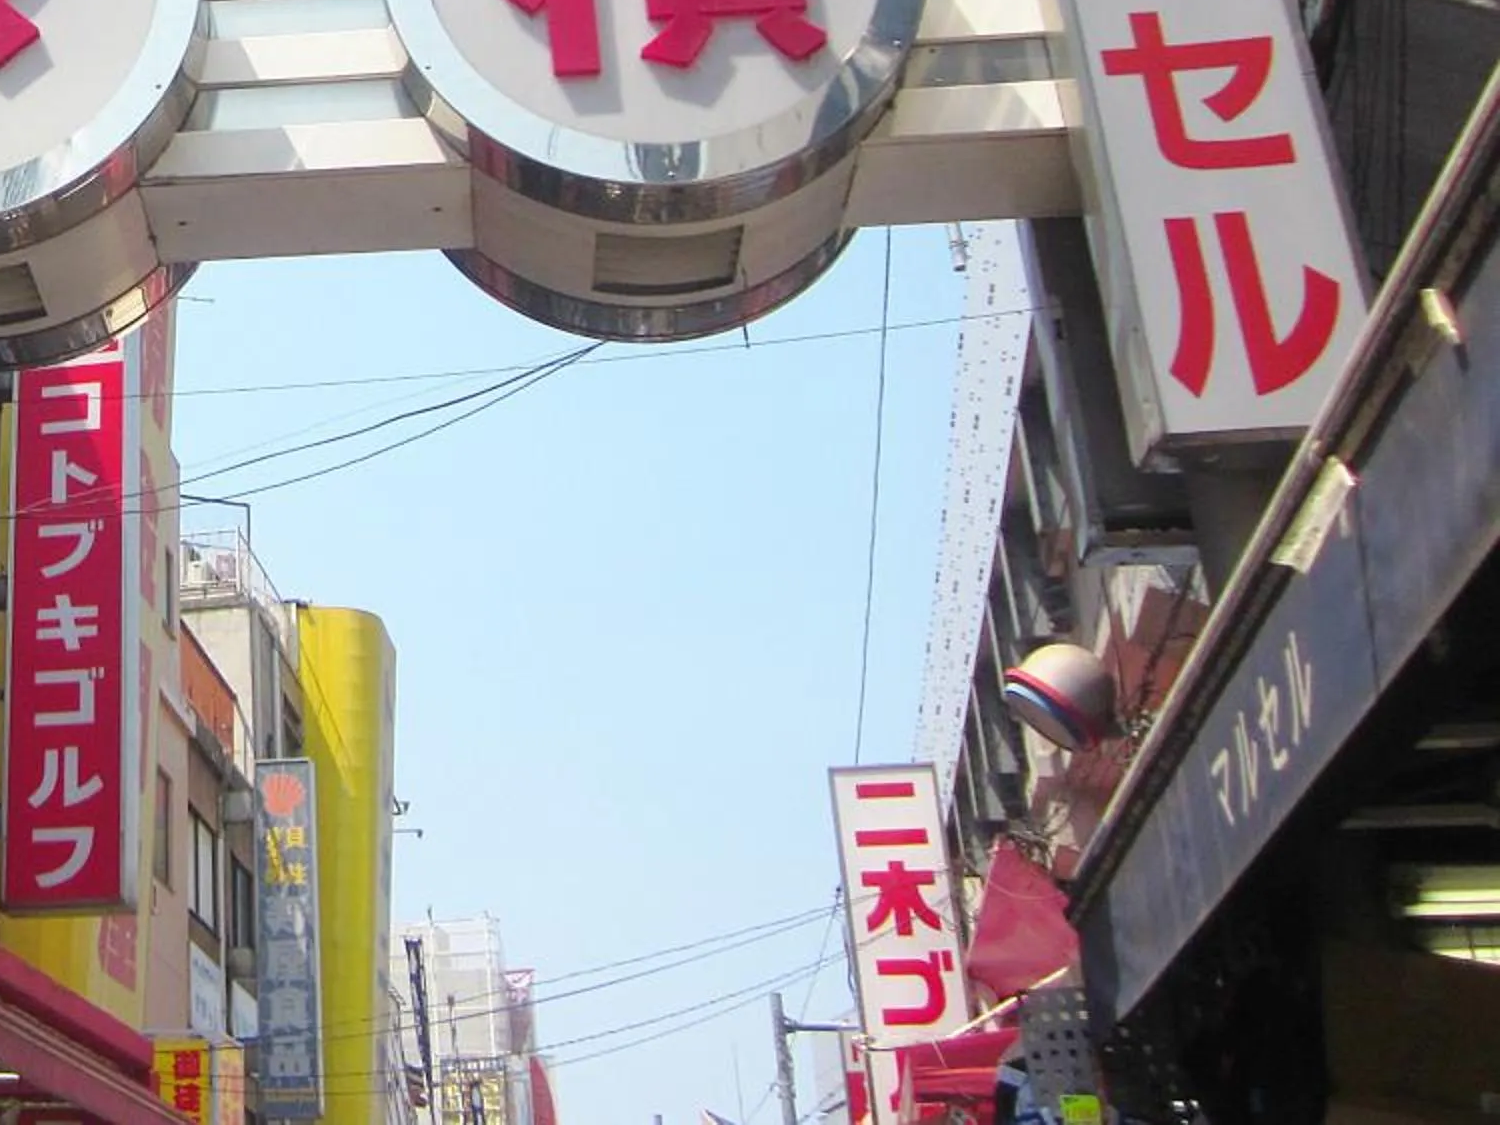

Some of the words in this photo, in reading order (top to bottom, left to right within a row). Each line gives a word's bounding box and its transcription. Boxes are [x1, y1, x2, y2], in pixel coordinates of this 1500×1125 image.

[27, 381, 105, 889] コトブキゴルフ
[1211, 631, 1312, 826] マルセル
